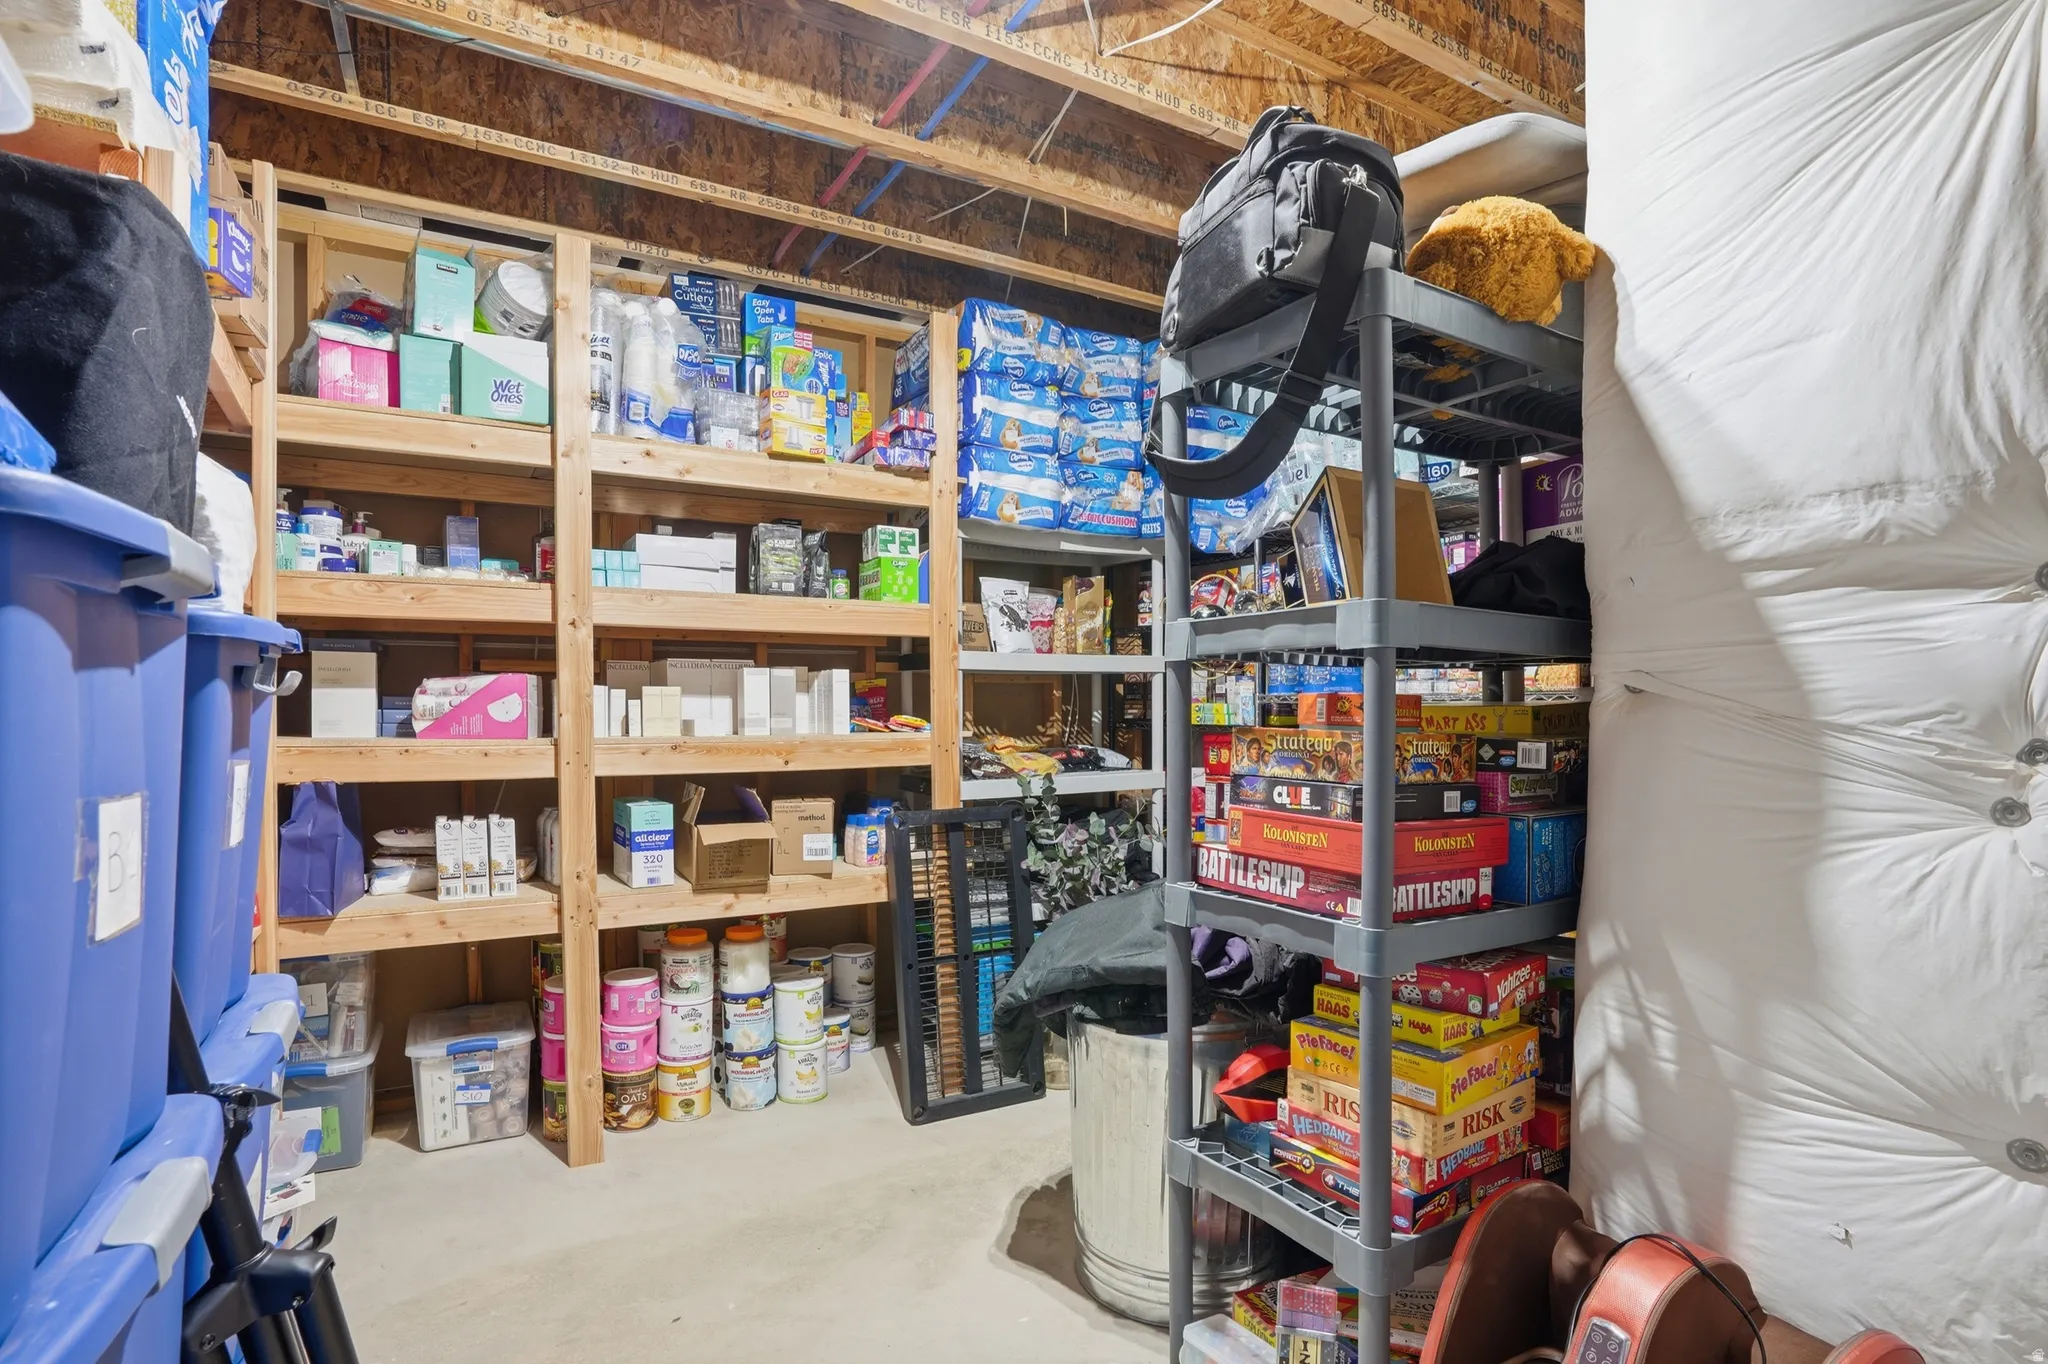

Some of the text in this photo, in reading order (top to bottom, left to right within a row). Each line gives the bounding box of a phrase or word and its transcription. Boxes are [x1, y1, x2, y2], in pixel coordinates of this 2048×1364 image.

[940, 5, 972, 30] ESR
[584, 43, 641, 68] 14:47
[1430, 31, 1471, 62] 25538
[1478, 57, 1534, 96] 04-02-10
[1538, 88, 1571, 115] 01:49
[412, 111, 447, 130] ESR
[756, 195, 801, 215] 25538
[882, 226, 923, 245] 06:13
[820, 280, 842, 294] ESR
[674, 289, 715, 306] Cutlery
[752, 298, 771, 308] Easy
[754, 306, 775, 317] Open
[757, 315, 775, 324] Tabs
[492, 378, 525, 394] Wet
[490, 391, 524, 405] Ones
[1122, 401, 1137, 410] 30
[1464, 712, 1488, 732] ASS
[1264, 733, 1335, 758] Stratego
[1404, 735, 1451, 759] Stratego
[1272, 785, 1311, 805] CLUE
[1263, 823, 1329, 849] KOLONISTEN
[1414, 832, 1476, 853] KOLONISTEN
[643, 854, 664, 864] 320
[1196, 847, 1305, 900] BATTLESHIP
[1496, 964, 1531, 1002] Yahtzee
[1316, 997, 1350, 1019] HAAS
[1408, 1018, 1434, 1036] HABA
[1443, 1021, 1469, 1043] HAAS
[621, 1092, 648, 1104] OATS
[1292, 1113, 1355, 1145] HEDBANZ
[1461, 1100, 1507, 1139] RISK
[1273, 1147, 1302, 1163] CONNECT
[1440, 1138, 1487, 1182] HEDBANZ
[1324, 1173, 1335, 1187] 4
